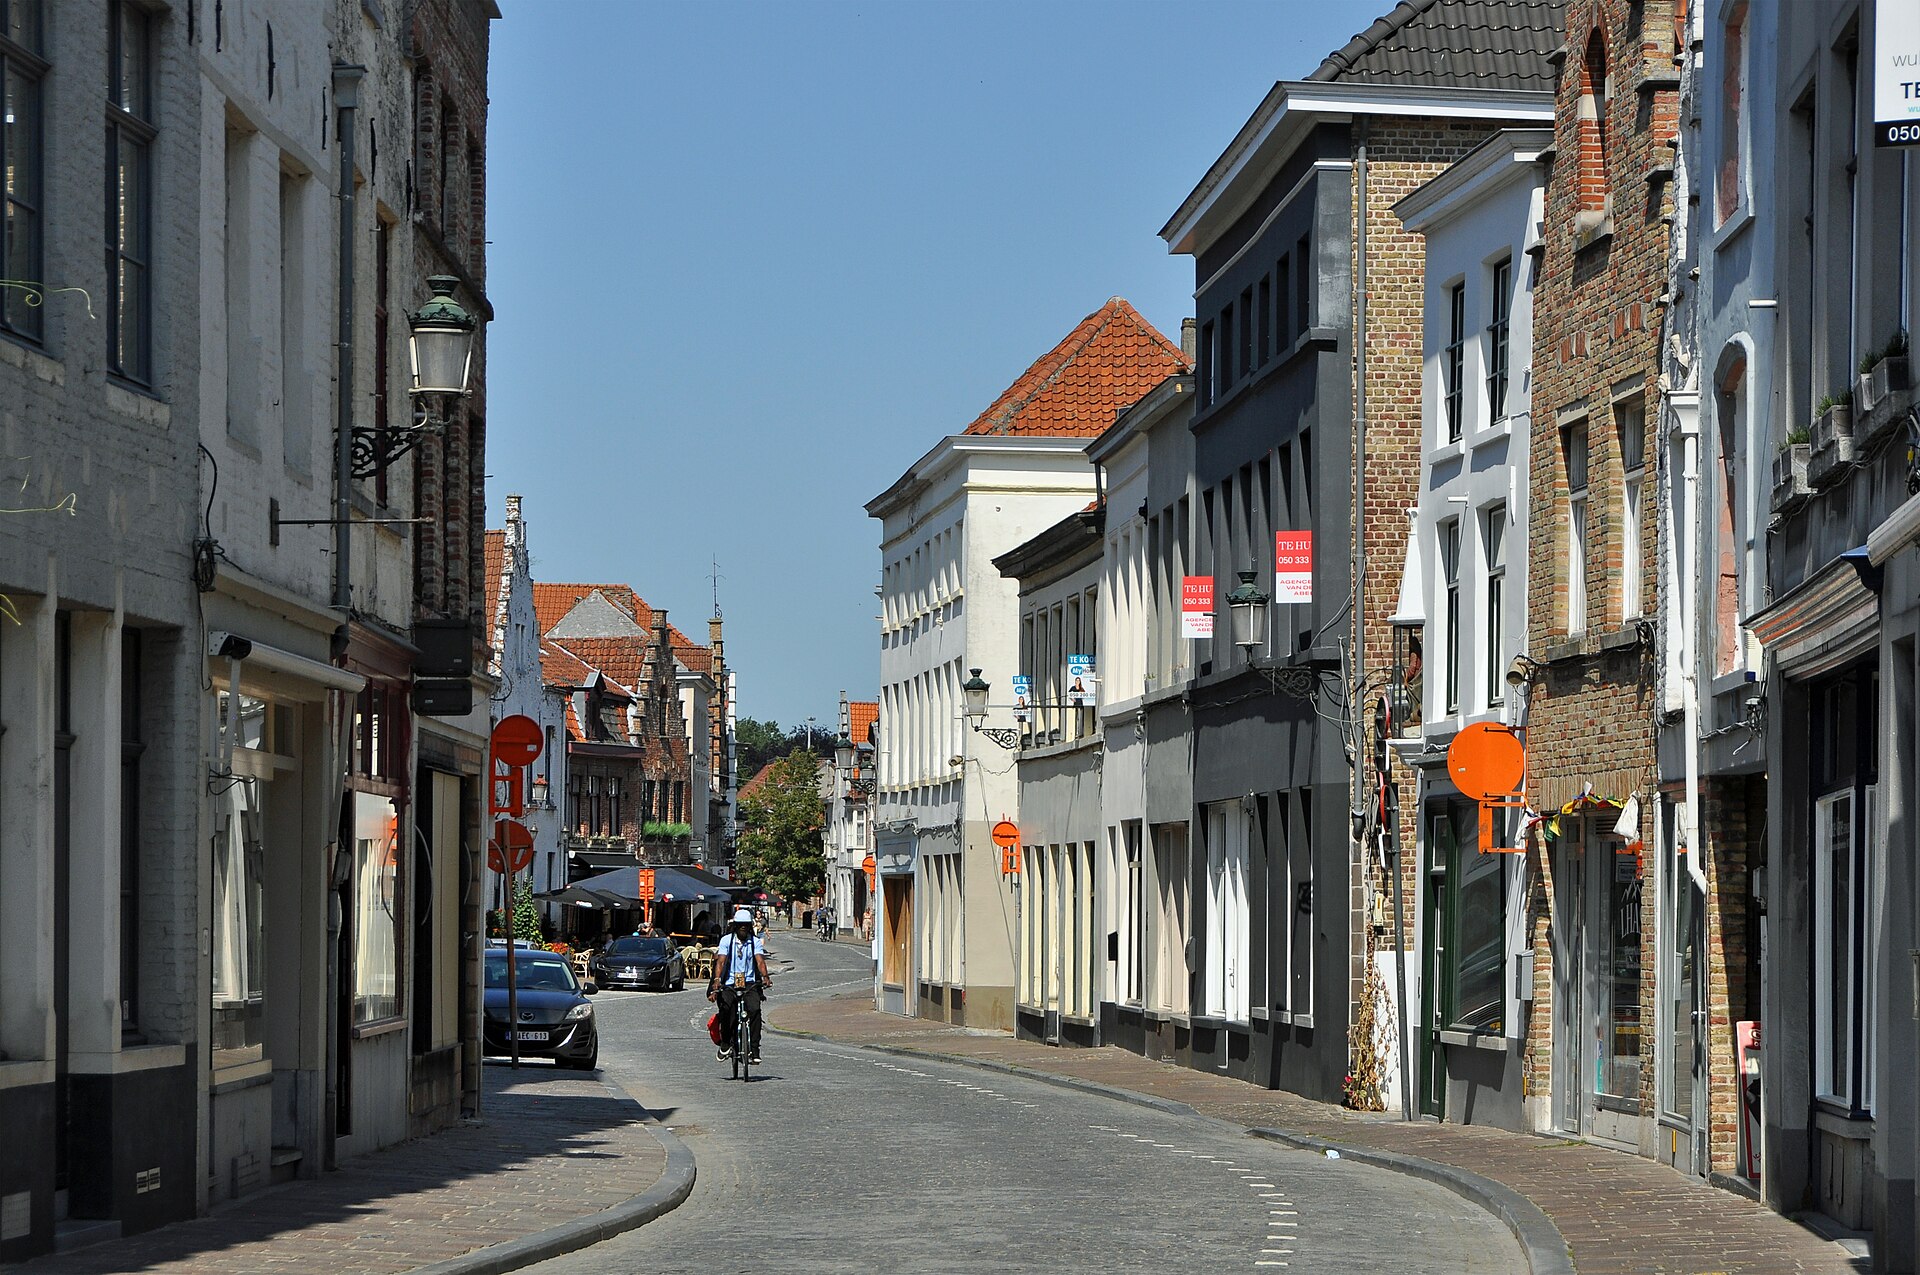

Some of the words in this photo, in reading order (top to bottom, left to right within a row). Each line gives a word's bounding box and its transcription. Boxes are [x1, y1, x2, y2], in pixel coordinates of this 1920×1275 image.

[1889, 125, 1920, 141] 050
[1279, 541, 1294, 550] TE
[1295, 541, 1311, 550] HU
[1278, 556, 1293, 564] 050
[1295, 556, 1309, 564] 333
[1184, 584, 1197, 593] TE
[1198, 584, 1213, 593] HU
[1183, 597, 1197, 605] 050
[1198, 597, 1211, 605] 333
[1070, 656, 1078, 664] TE
[1014, 676, 1021, 684] TE
